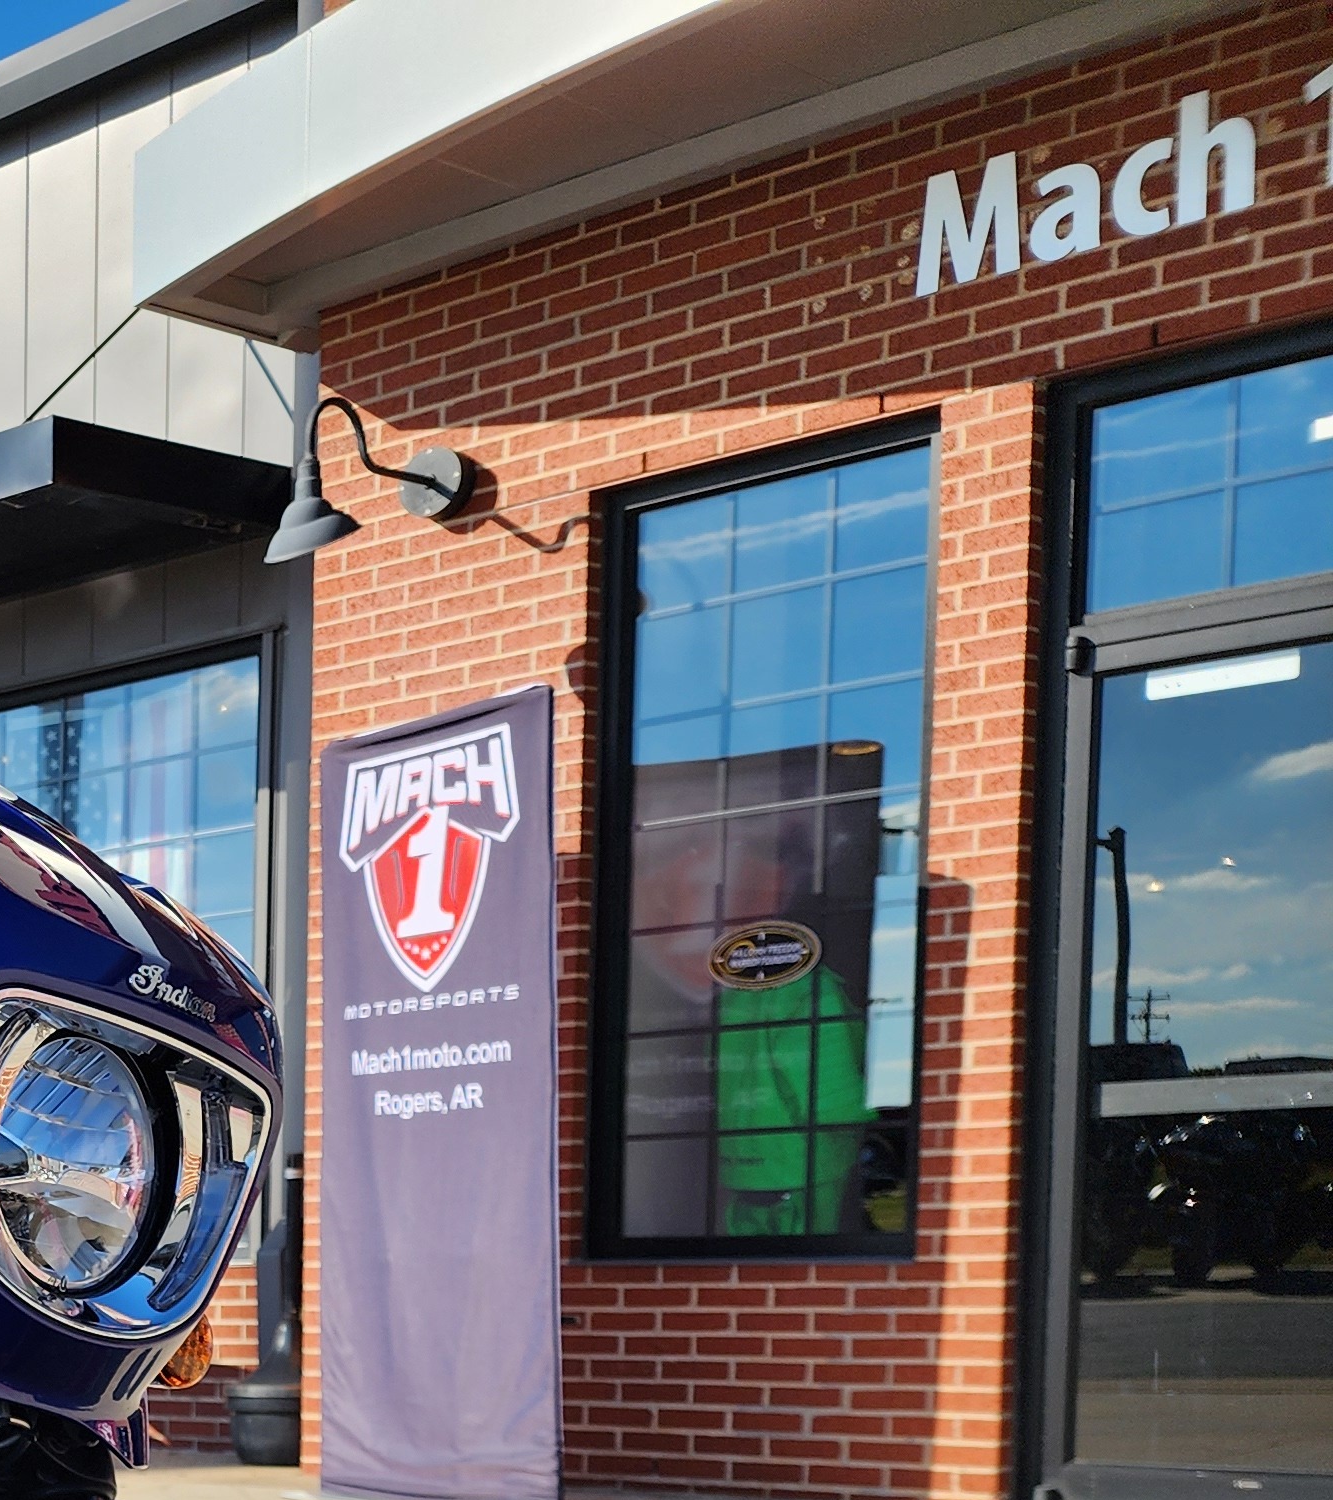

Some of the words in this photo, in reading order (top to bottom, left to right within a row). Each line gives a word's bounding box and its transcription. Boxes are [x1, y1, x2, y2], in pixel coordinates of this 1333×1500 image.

[915, 89, 1256, 298] Mach
[349, 737, 511, 852] MACH
[396, 806, 455, 938] 1
[128, 964, 216, 1022] Indian
[344, 984, 520, 1020] MOTORSPORTS
[351, 1040, 511, 1075] Mach1moto.com
[374, 1089, 448, 1121] Rogers,
[450, 1083, 484, 1111] AR
